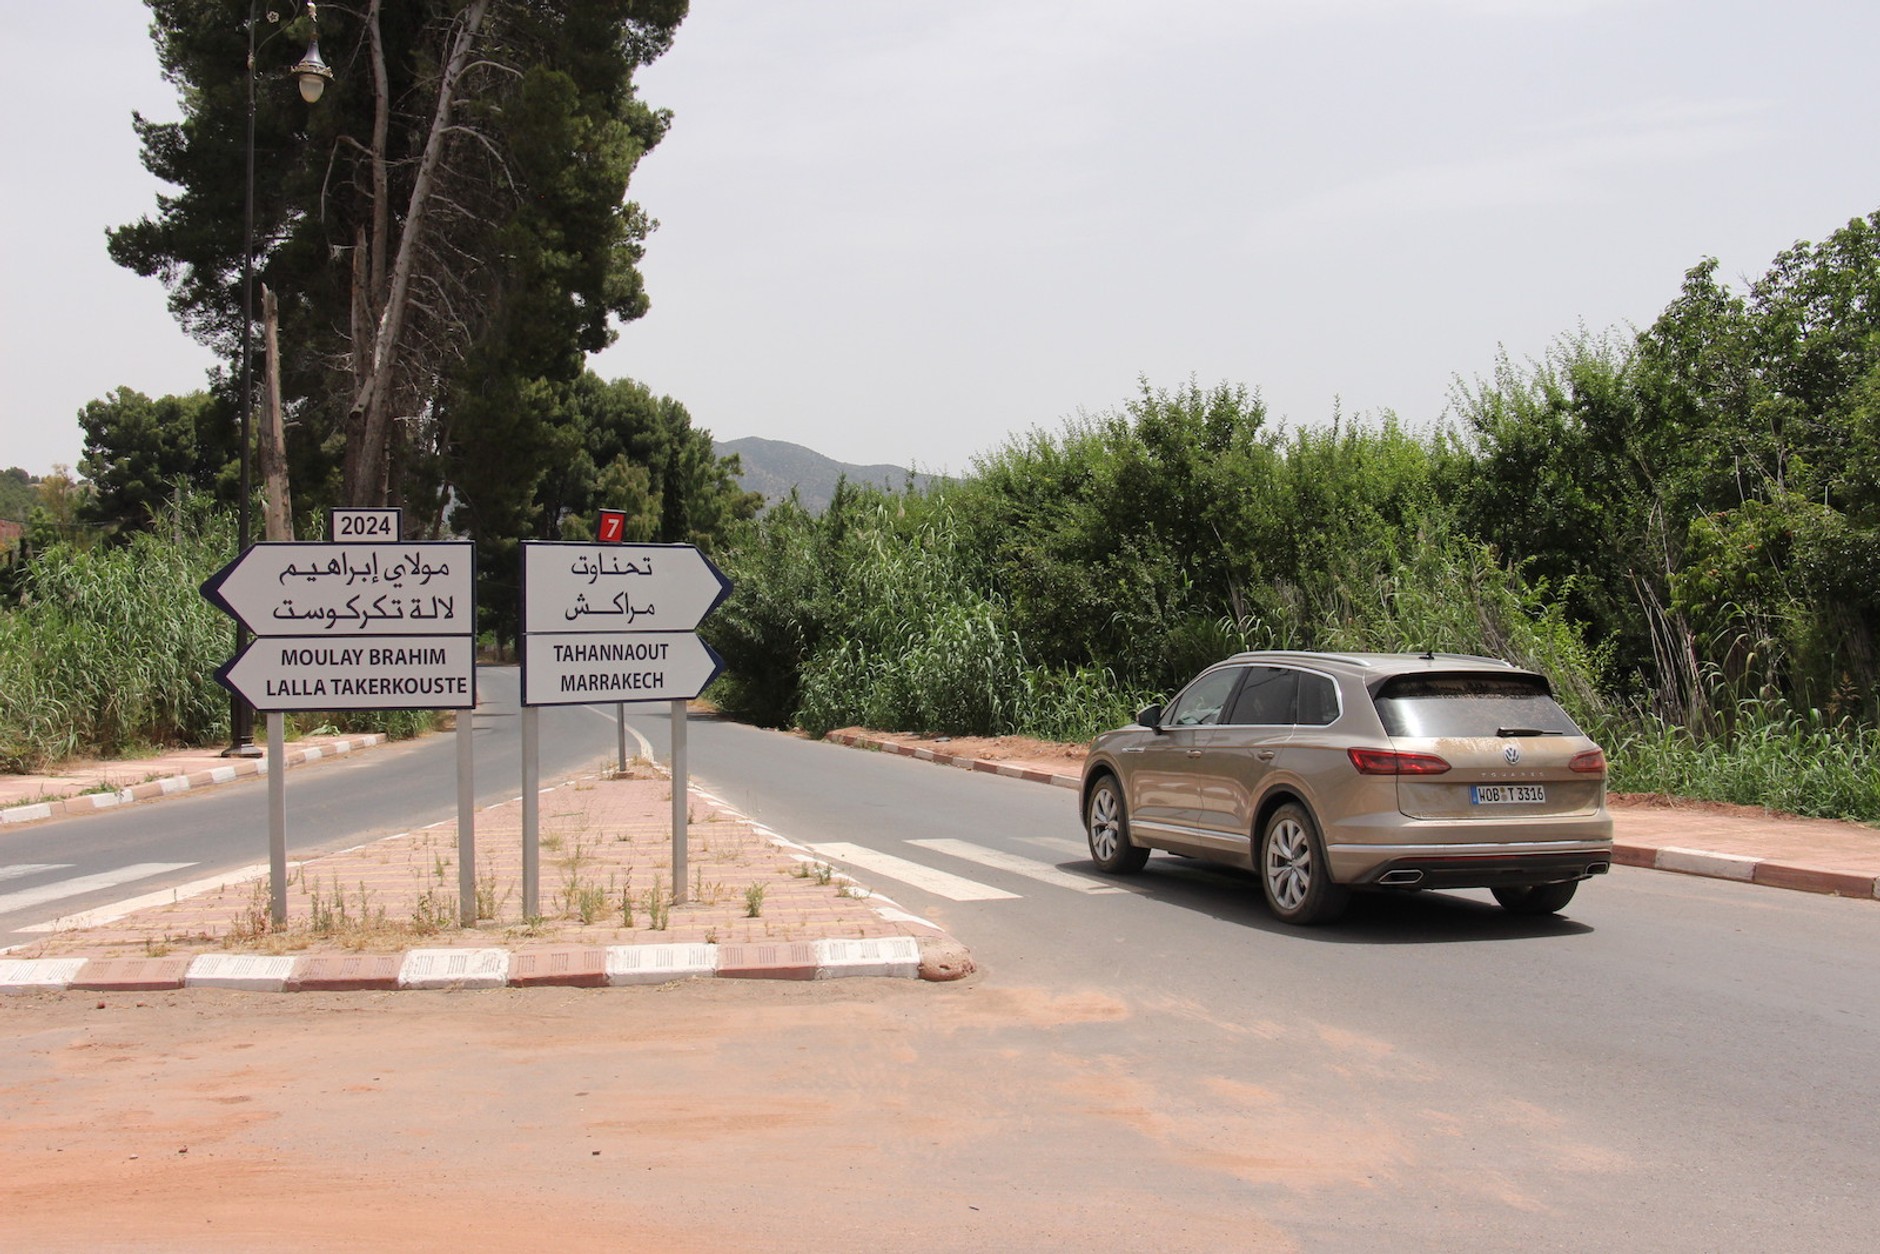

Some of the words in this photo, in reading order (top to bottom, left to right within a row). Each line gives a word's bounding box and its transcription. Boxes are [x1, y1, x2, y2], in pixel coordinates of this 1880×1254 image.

[341, 516, 391, 535] 2024
[607, 518, 619, 538] 7
[279, 551, 379, 586] إبراهيم
[384, 551, 449, 588] مولاي
[571, 552, 652, 584] تحناوت
[272, 594, 404, 629] تكركوست
[409, 596, 454, 619] لالة
[565, 591, 655, 624] مراكش
[281, 649, 364, 666] MOULAY
[369, 648, 446, 665] BRAHIM
[553, 643, 669, 662] TAHANNAOUT
[266, 678, 326, 696] LALLA
[330, 676, 467, 695] TAKERKOUSTE
[561, 672, 664, 692] MARRAKECH
[1507, 787, 1514, 801] T
[1518, 787, 1544, 801] 3316
